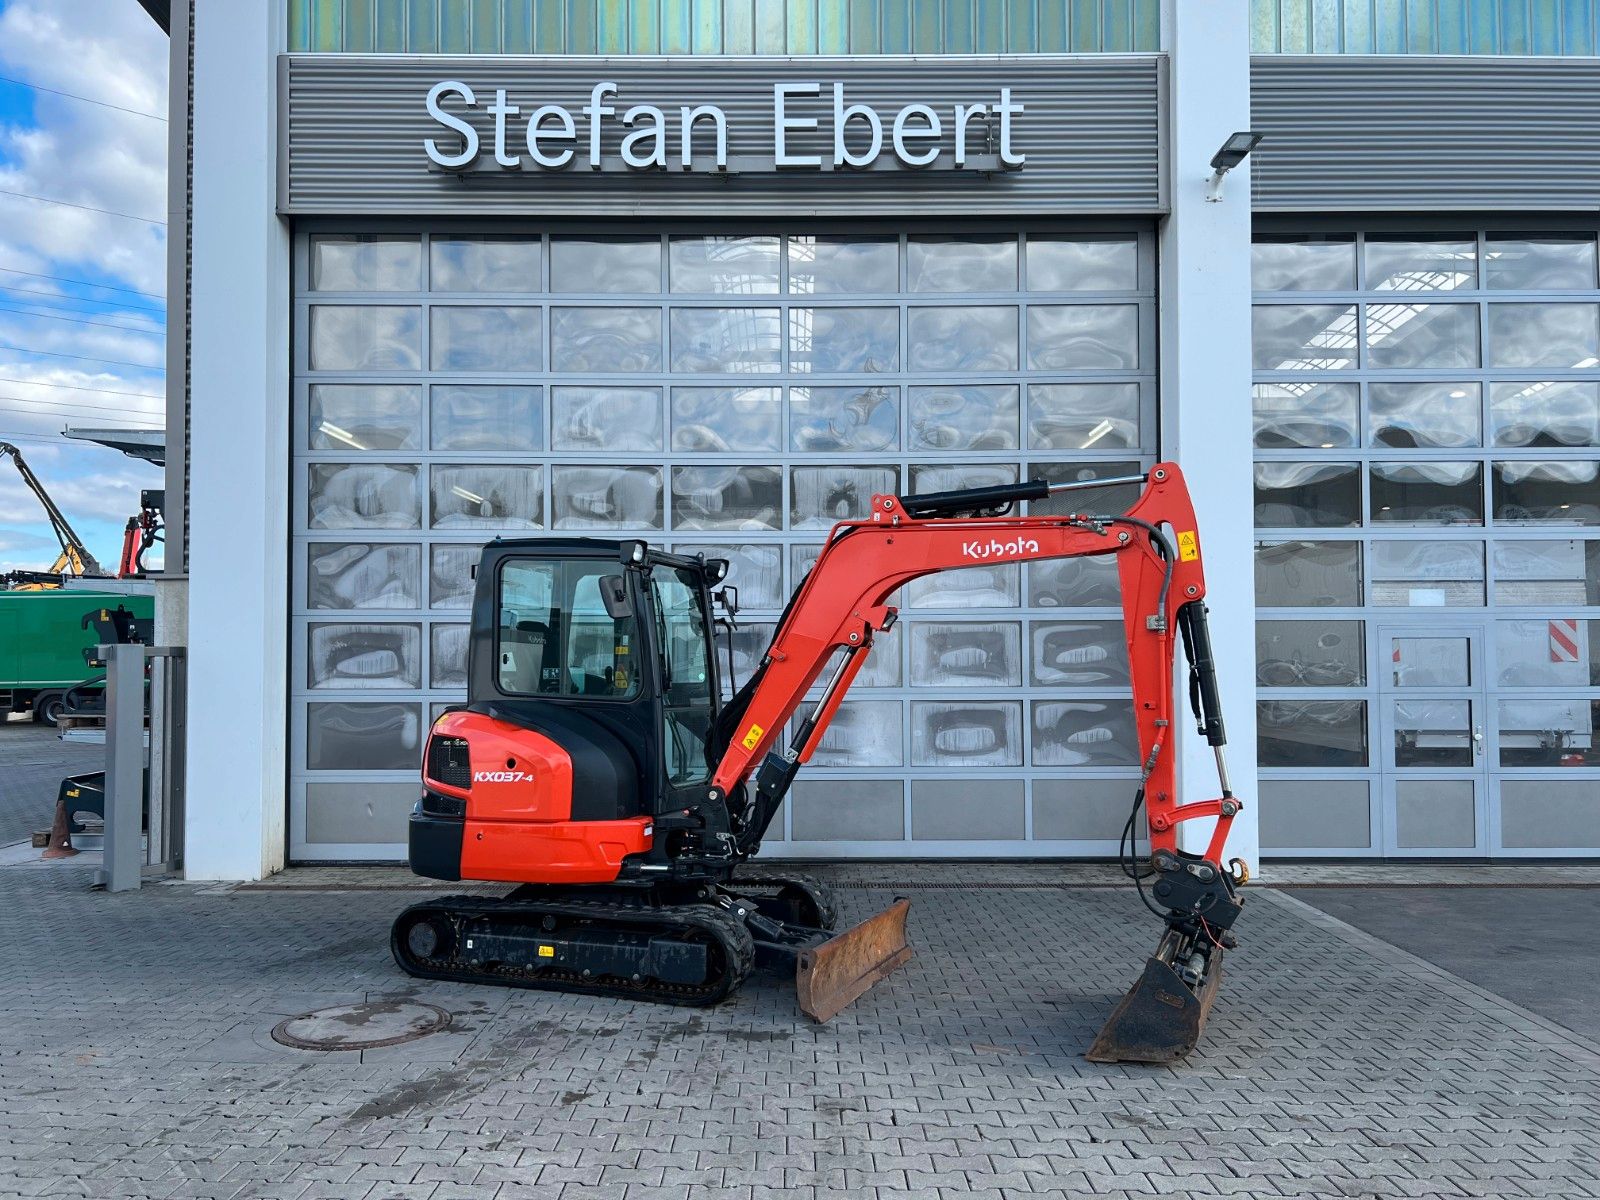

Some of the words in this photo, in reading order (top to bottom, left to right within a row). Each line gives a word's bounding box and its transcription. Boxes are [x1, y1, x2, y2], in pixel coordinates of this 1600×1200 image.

[424, 80, 727, 169] Stefan
[774, 82, 1026, 169] Ebert
[962, 536, 1039, 559] Kubota
[473, 771, 534, 783] KX037-4
